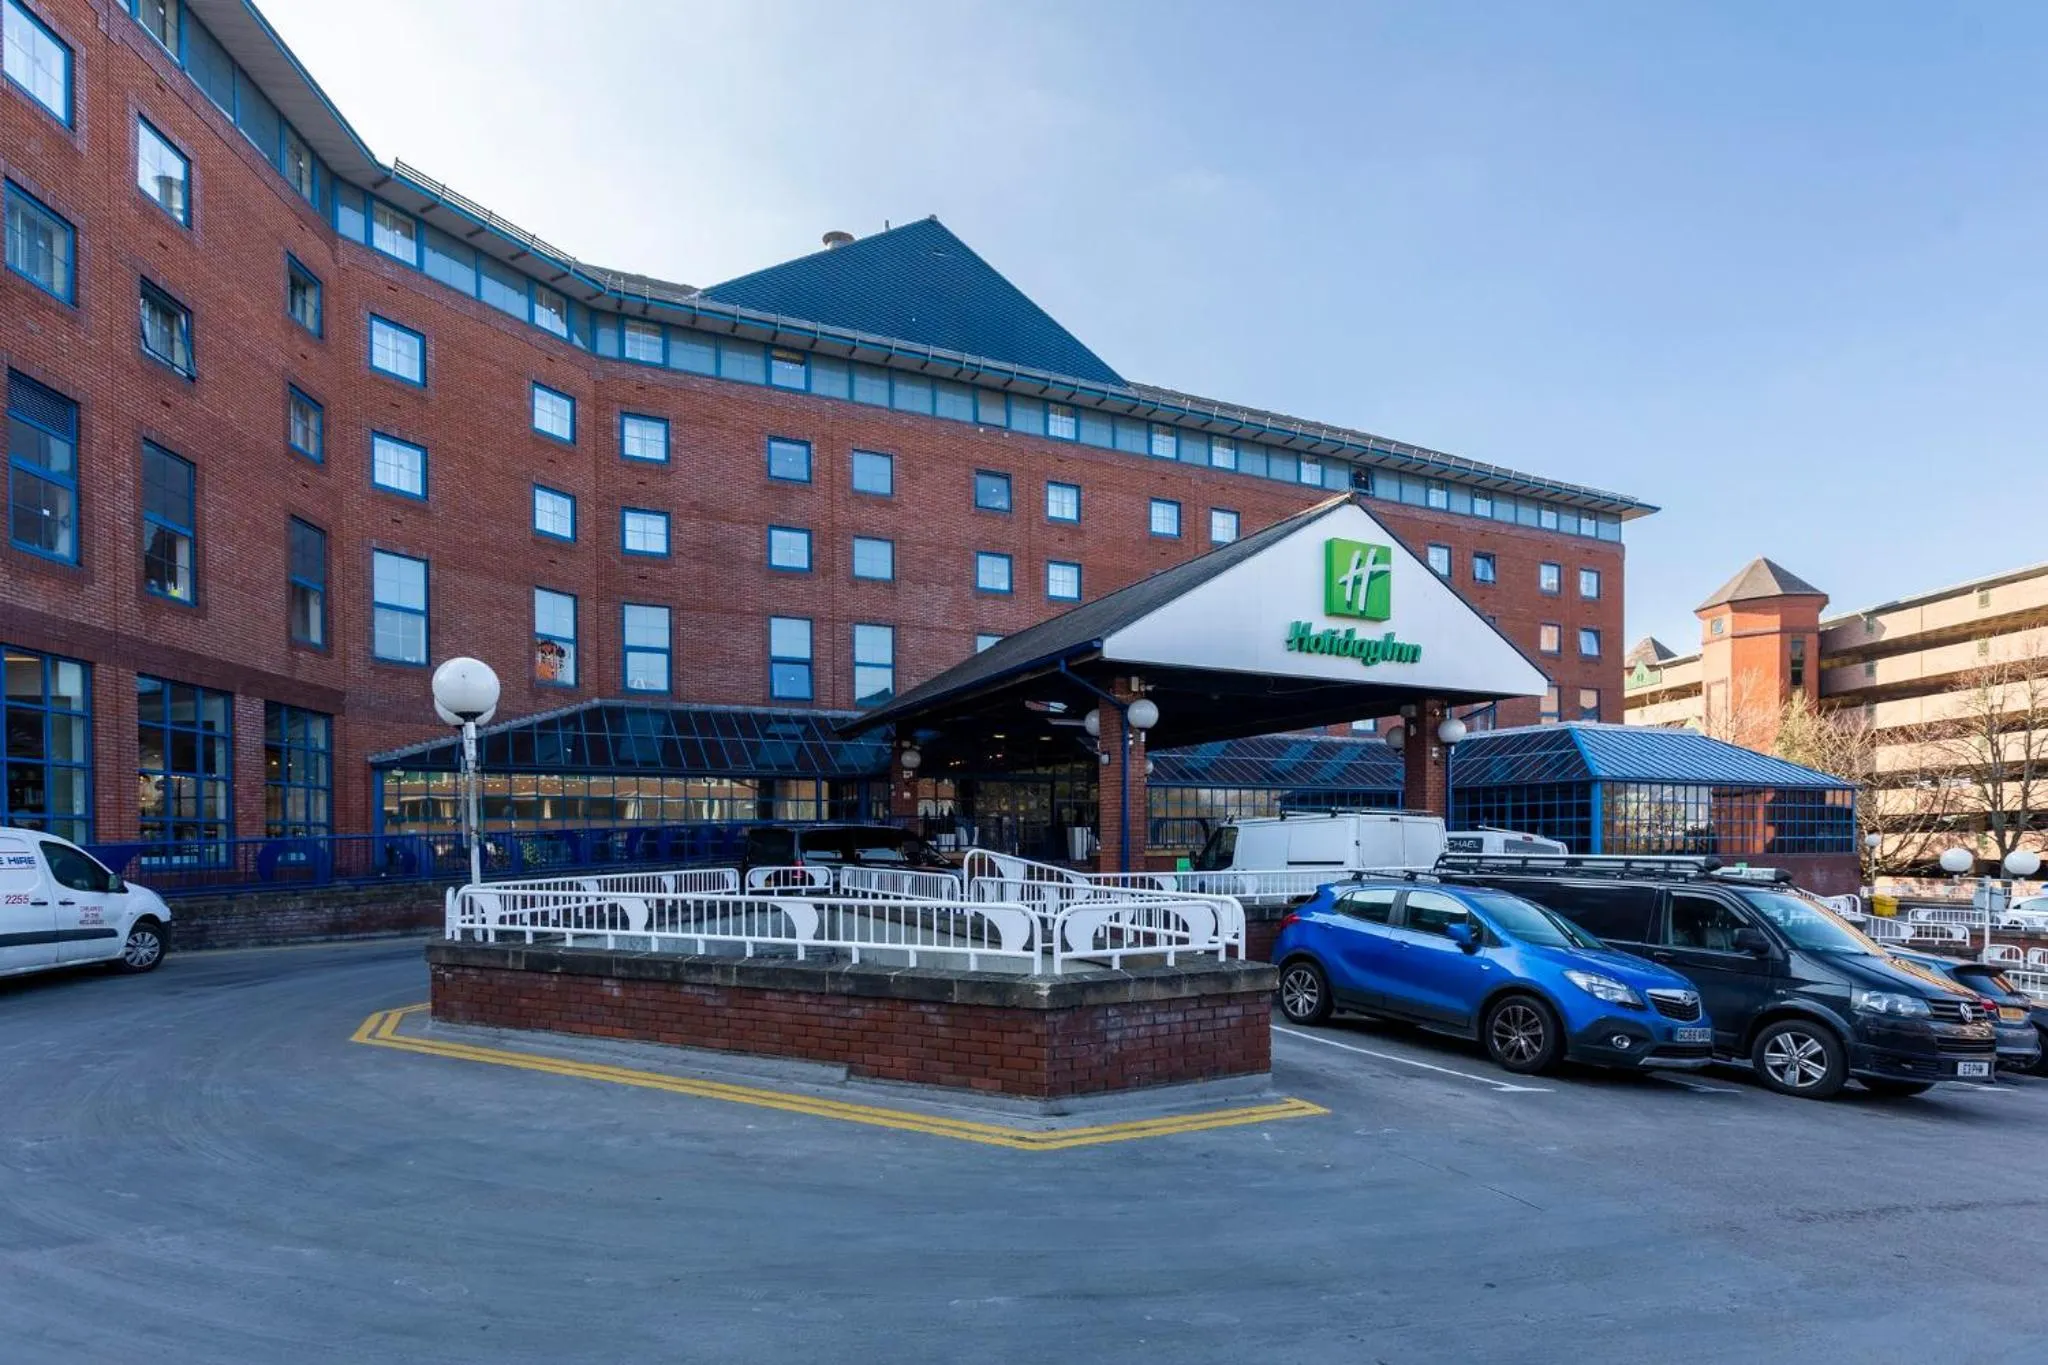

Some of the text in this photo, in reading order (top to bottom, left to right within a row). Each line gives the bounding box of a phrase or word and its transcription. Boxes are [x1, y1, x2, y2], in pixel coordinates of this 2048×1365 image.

[1286, 620, 1422, 666] Holiday Inn
[7, 856, 36, 865] HIRE
[5, 895, 30, 905] 2255
